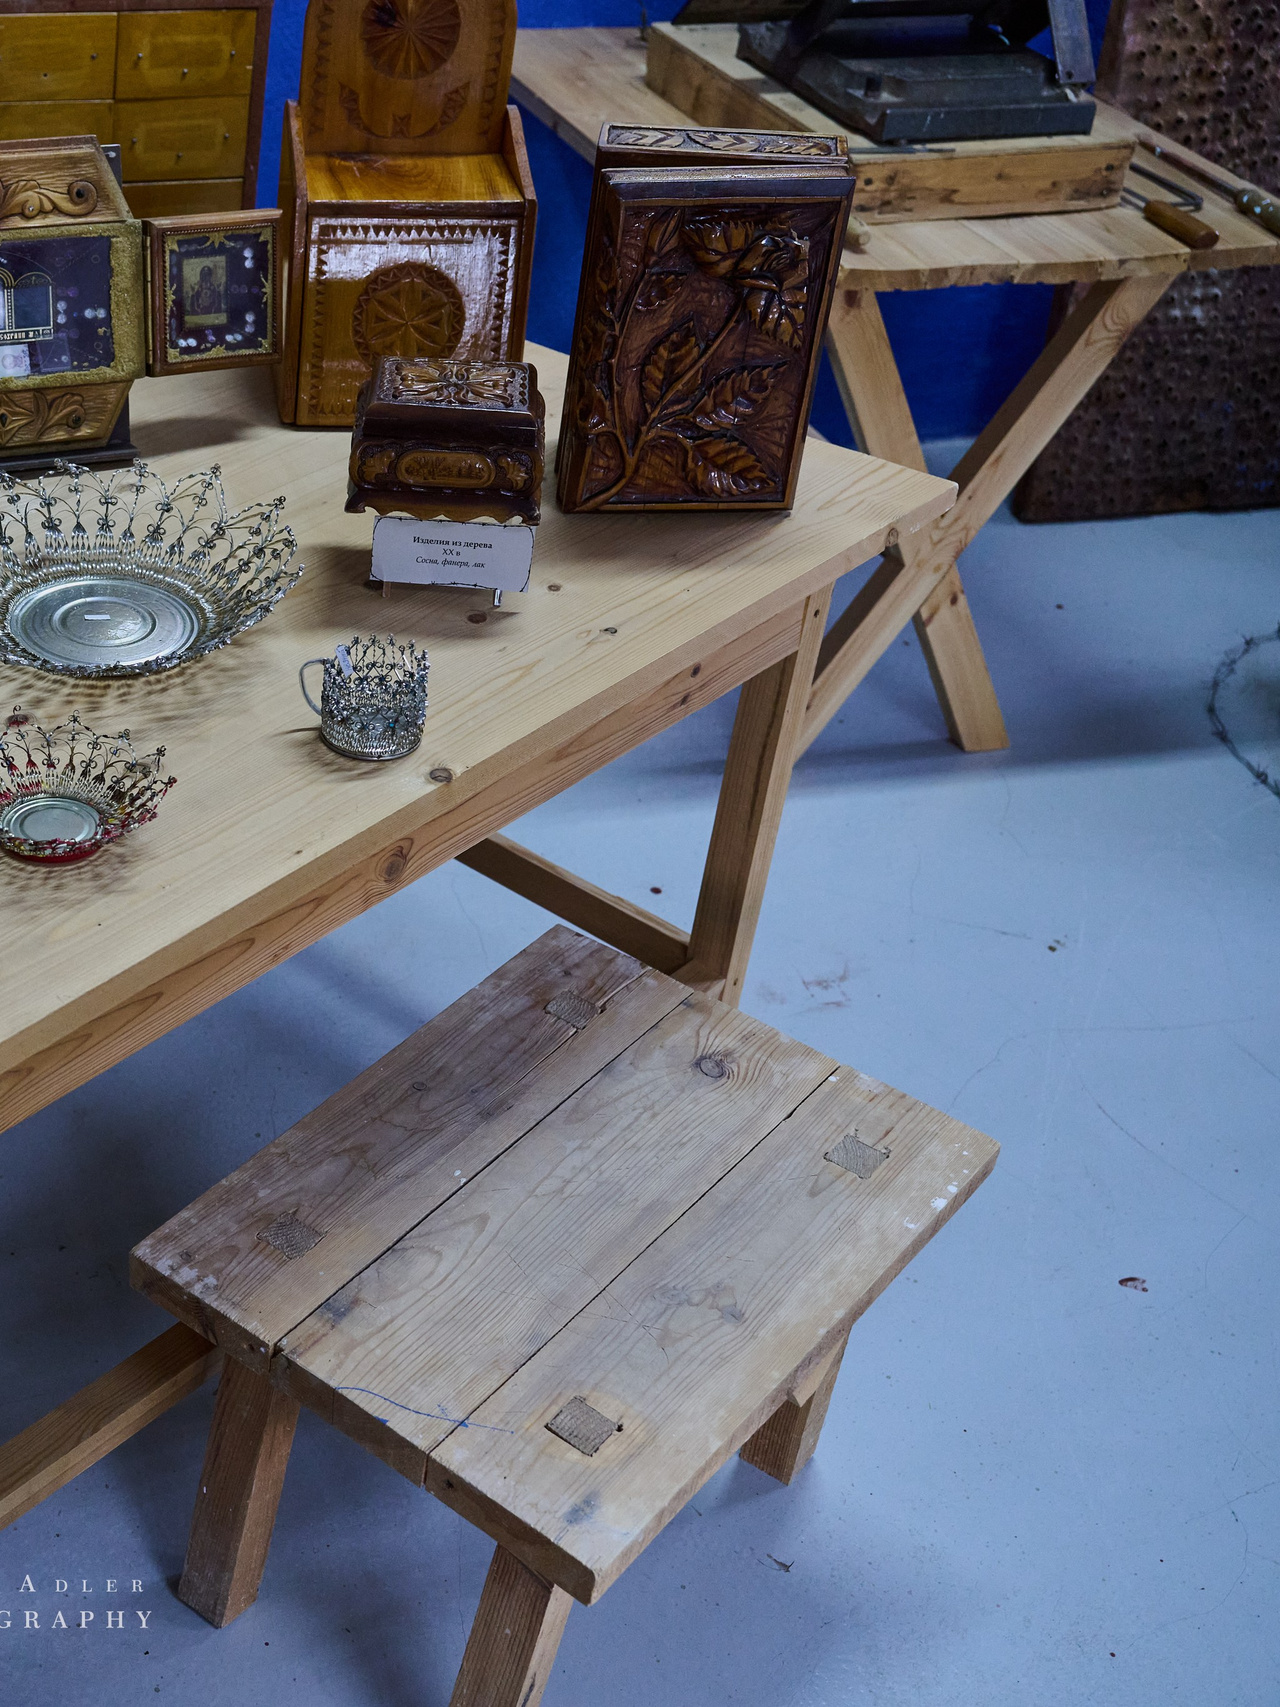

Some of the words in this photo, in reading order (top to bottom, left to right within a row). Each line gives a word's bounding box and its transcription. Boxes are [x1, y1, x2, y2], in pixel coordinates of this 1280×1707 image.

[412, 536, 450, 546] Изделия
[463, 541, 493, 549] дерева
[415, 556, 440, 565] Сосна,
[441, 558, 470, 569] фанера,
